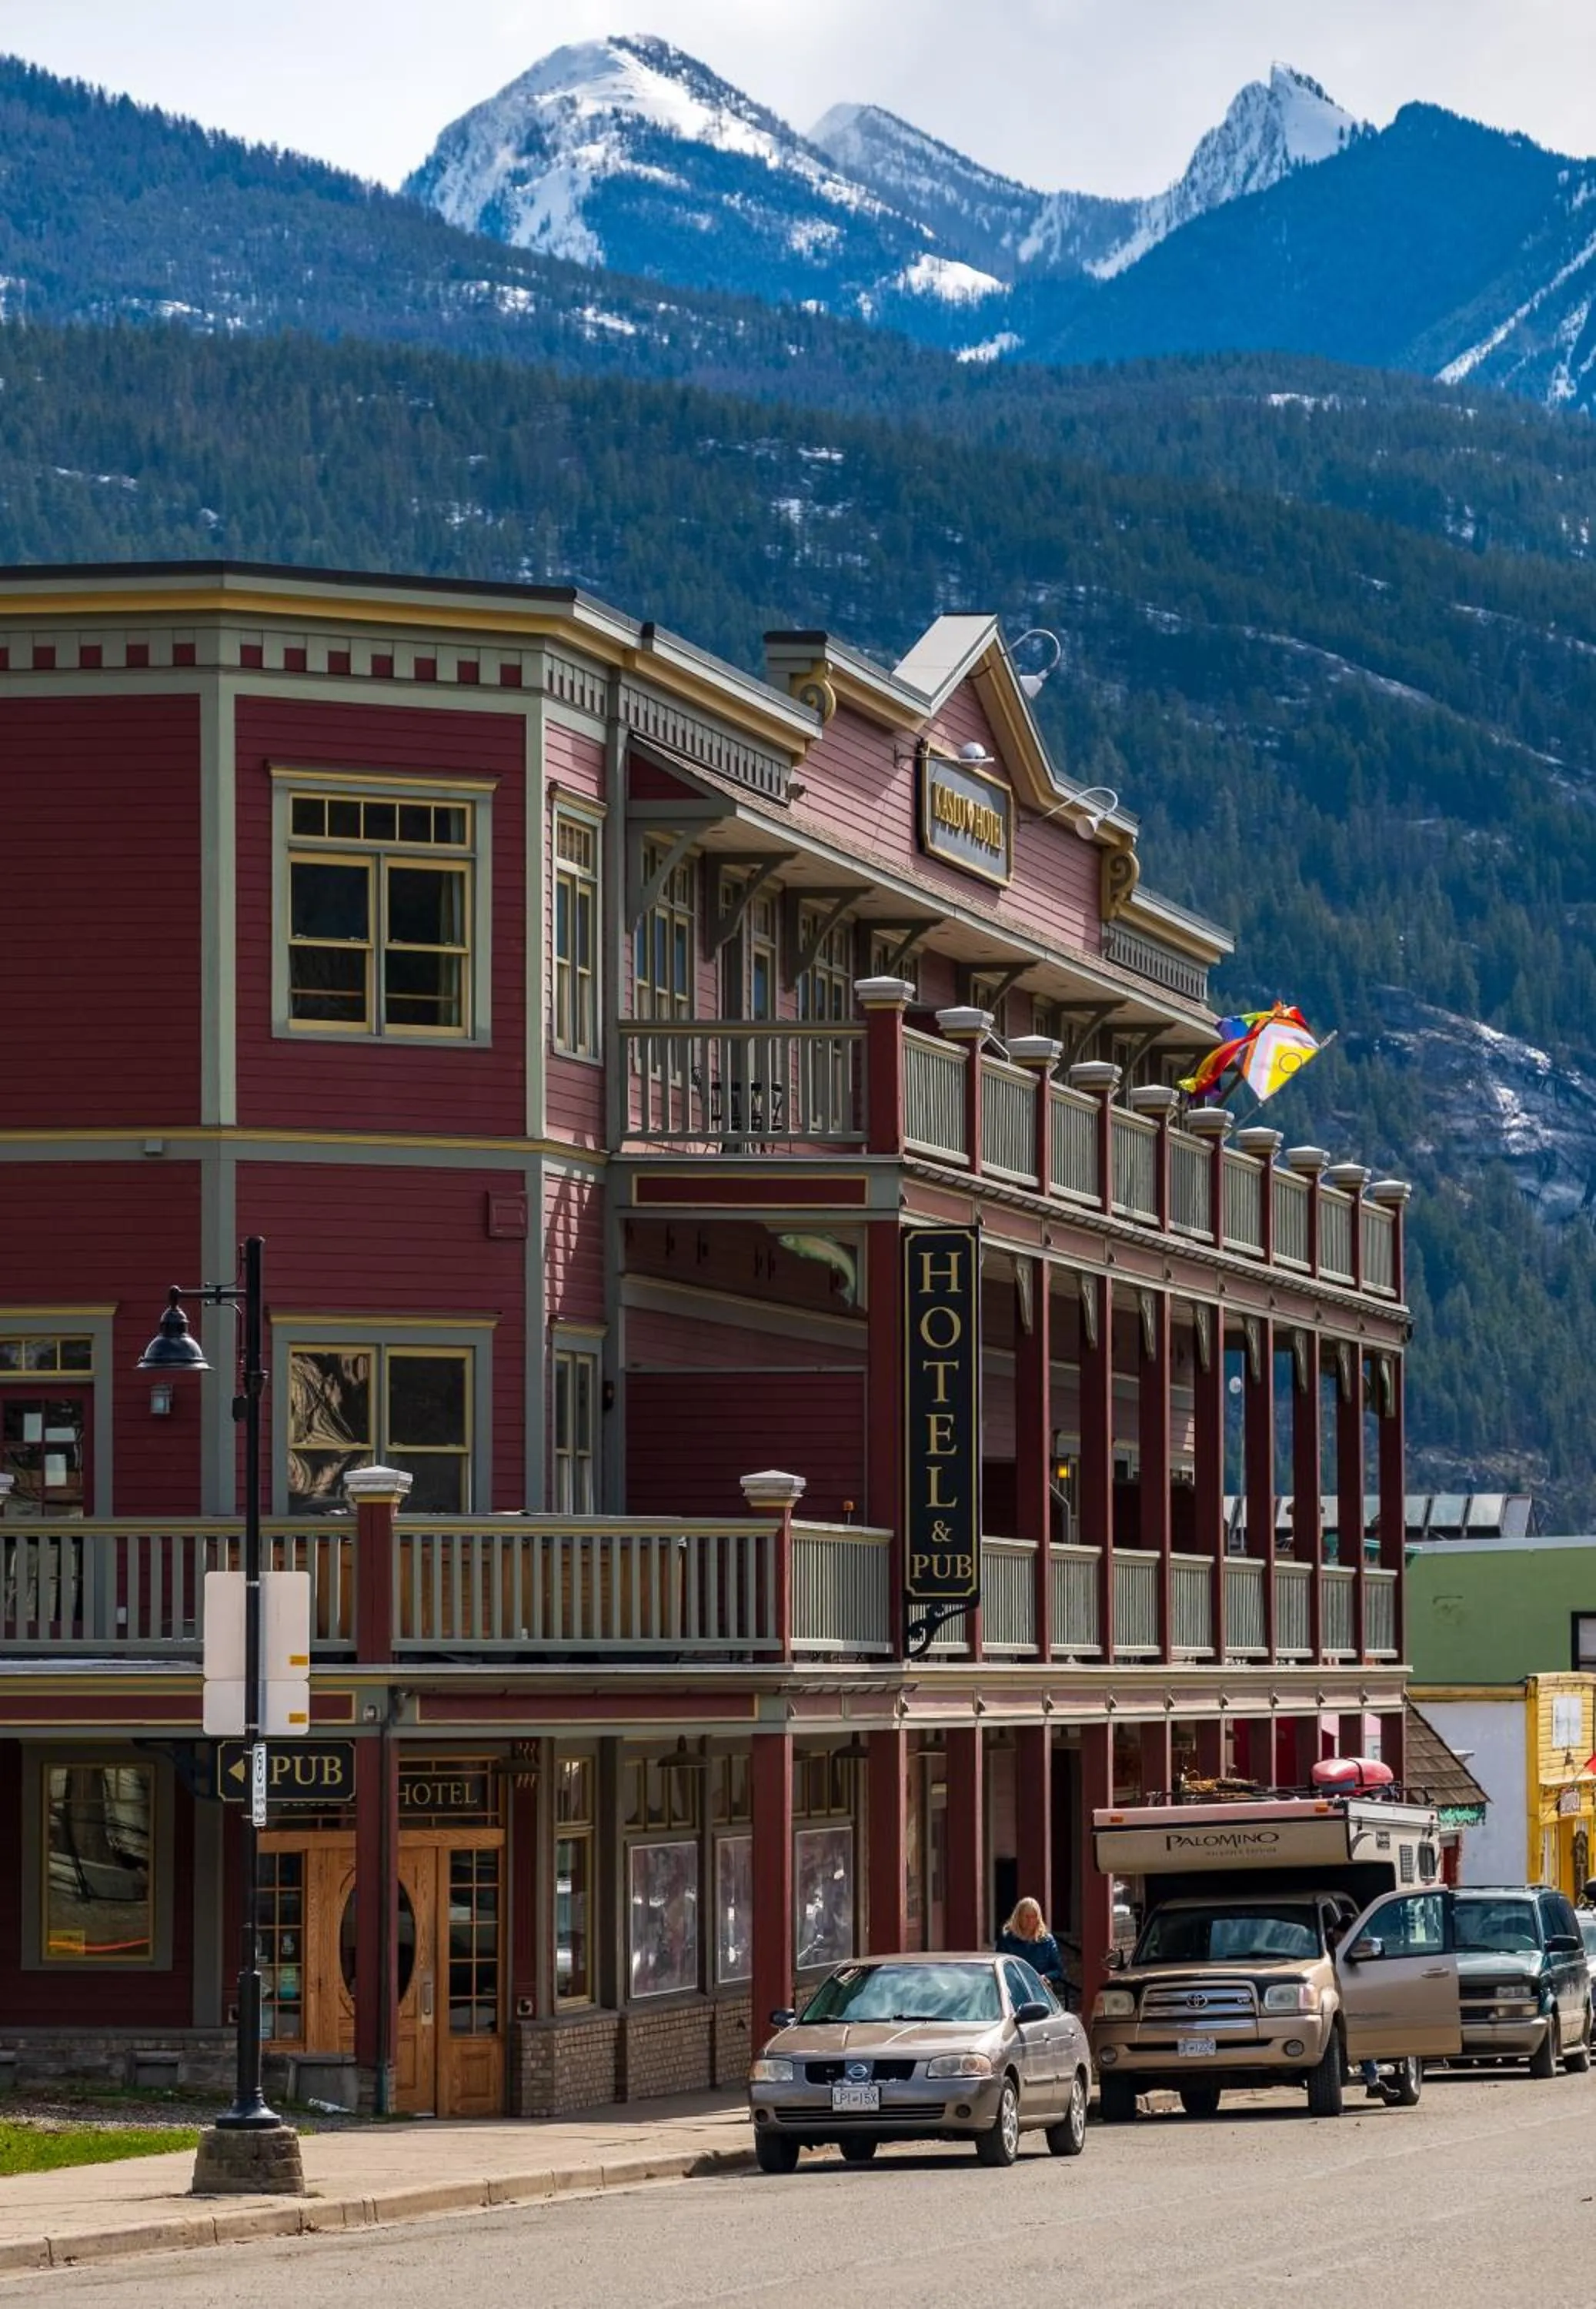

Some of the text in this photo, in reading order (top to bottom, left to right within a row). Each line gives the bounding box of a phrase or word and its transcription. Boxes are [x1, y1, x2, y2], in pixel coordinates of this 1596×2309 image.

[918, 1251, 962, 1509] HOTEL
[931, 1519, 953, 1542] &
[911, 1554, 973, 1579] PUB
[269, 1756, 343, 1785] PUB
[396, 1782, 478, 1805] HOTEL
[1165, 1831, 1280, 1852] PALOMINO
